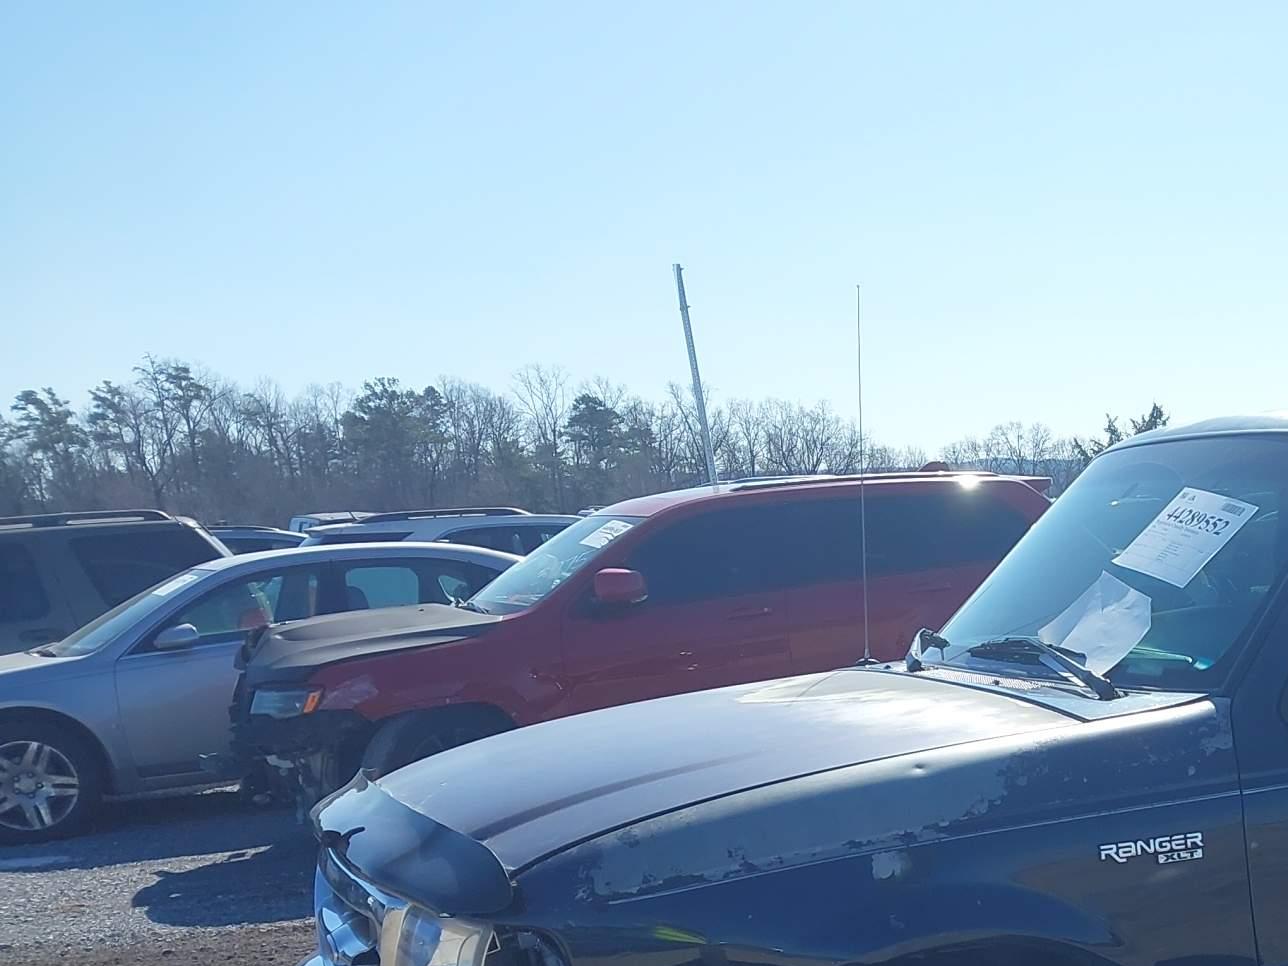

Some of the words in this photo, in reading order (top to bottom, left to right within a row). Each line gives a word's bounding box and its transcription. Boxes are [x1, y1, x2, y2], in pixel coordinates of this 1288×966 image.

[1166, 506, 1231, 536] 44289552
[1099, 831, 1204, 863] RANGER
[1161, 849, 1199, 863] XLT
